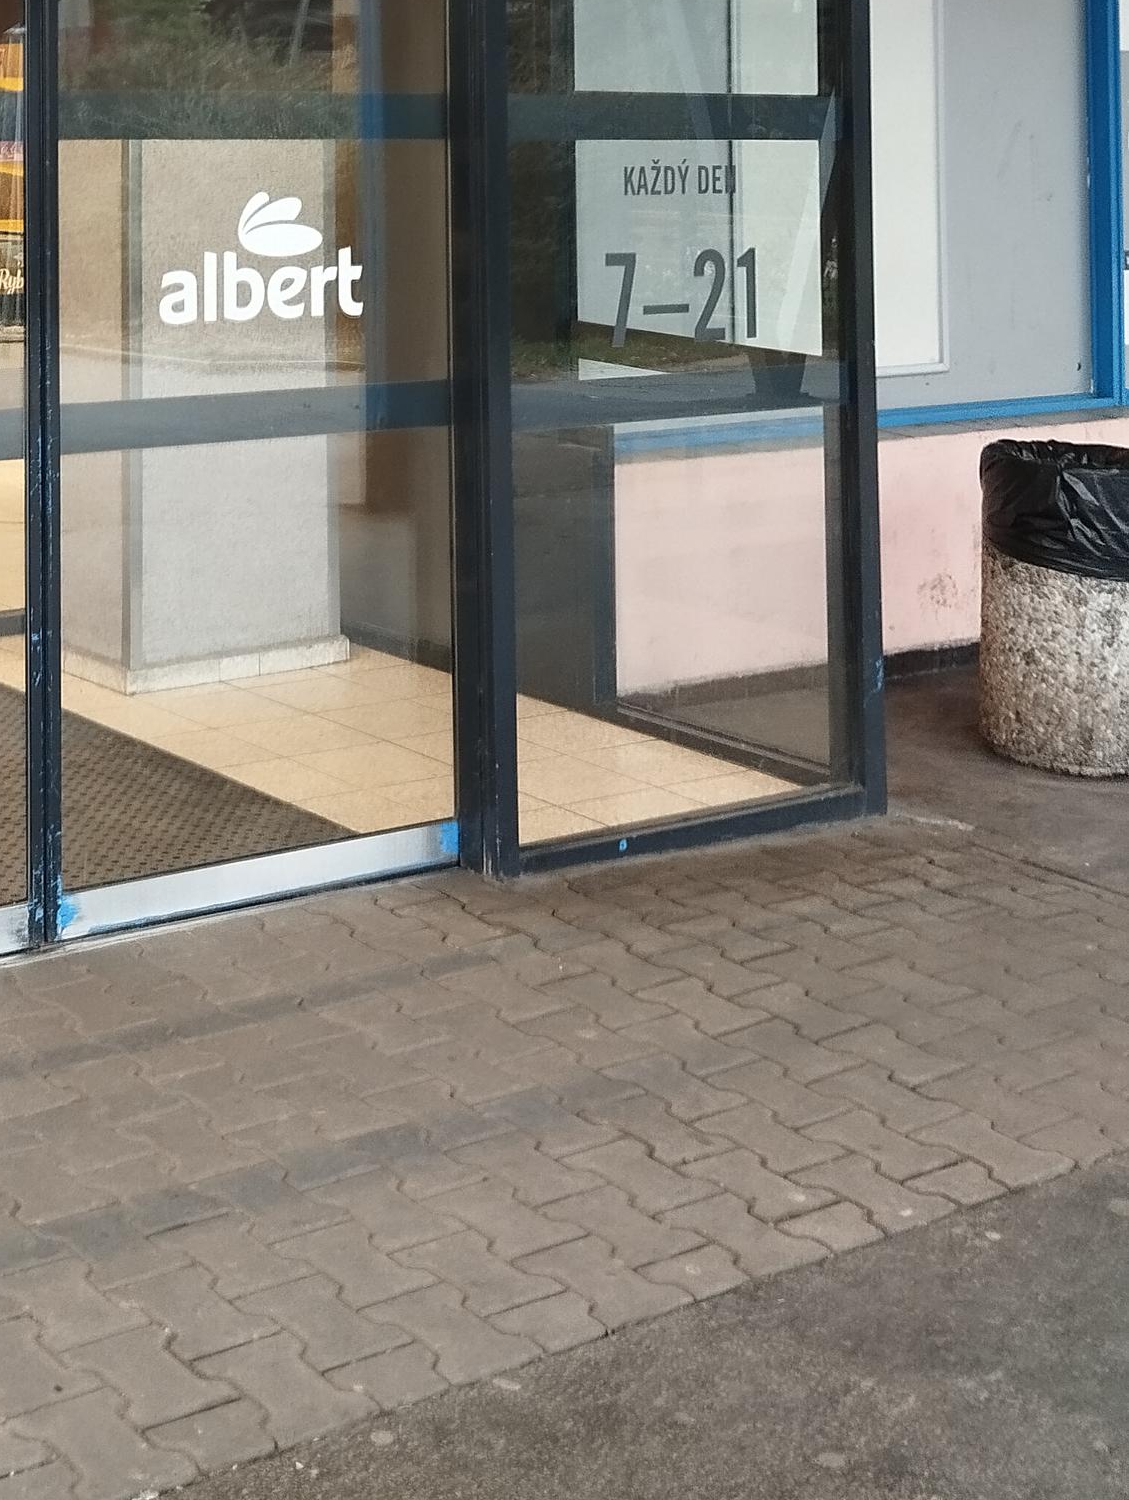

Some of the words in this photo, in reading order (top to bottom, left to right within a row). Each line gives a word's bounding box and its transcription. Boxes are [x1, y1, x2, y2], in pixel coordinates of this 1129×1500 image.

[624, 159, 690, 195] KAŽDÝ
[698, 164, 736, 194] DEN
[158, 245, 364, 325] albert
